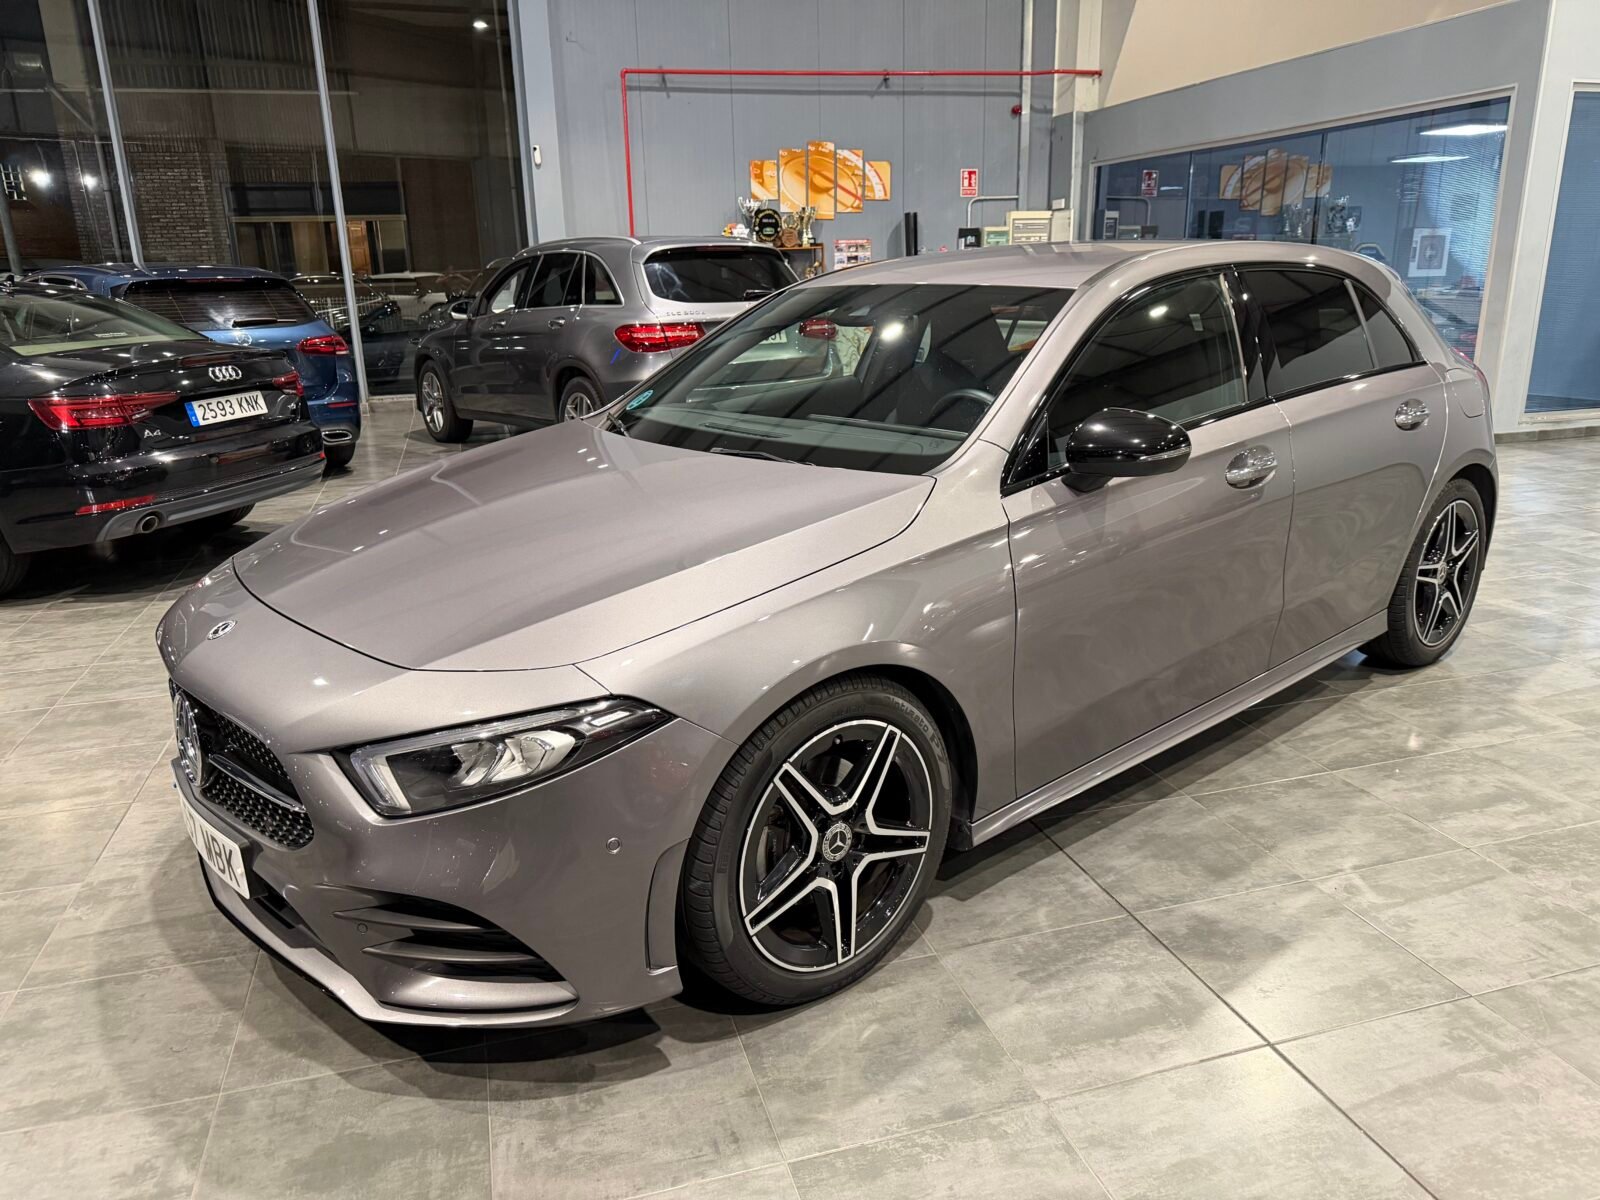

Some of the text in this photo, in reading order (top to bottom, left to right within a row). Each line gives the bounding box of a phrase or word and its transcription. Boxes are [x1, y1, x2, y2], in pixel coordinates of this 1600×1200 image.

[198, 394, 263, 421] 2593 KNK
[143, 429, 162, 439] A4
[199, 823, 241, 888] MBK
